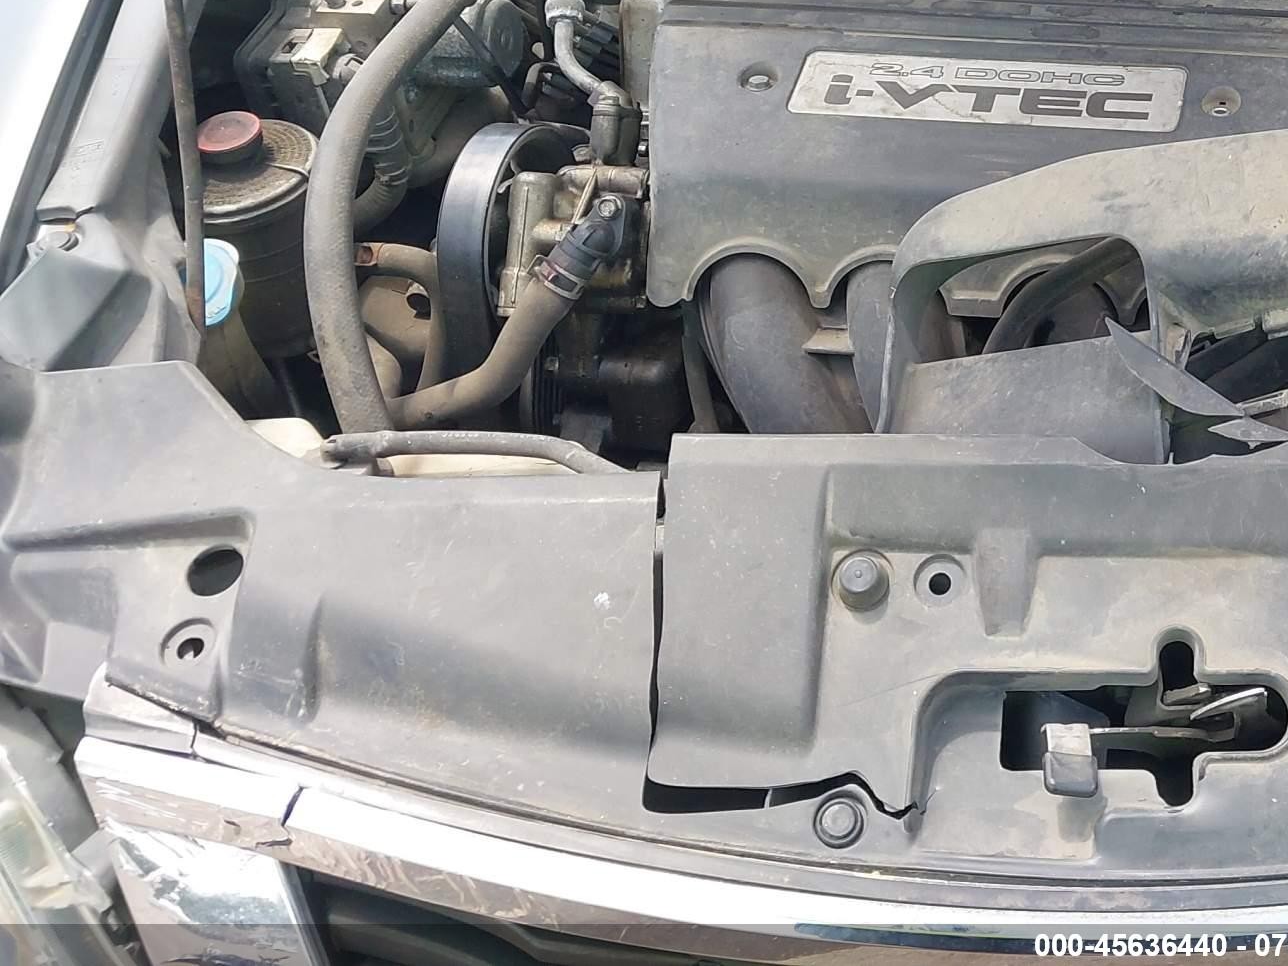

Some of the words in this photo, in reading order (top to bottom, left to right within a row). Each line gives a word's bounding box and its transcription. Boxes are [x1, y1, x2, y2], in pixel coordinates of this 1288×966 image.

[870, 62, 944, 79] 2.4
[955, 67, 1126, 86] DOHC
[823, 73, 1154, 120] i-VTEC
